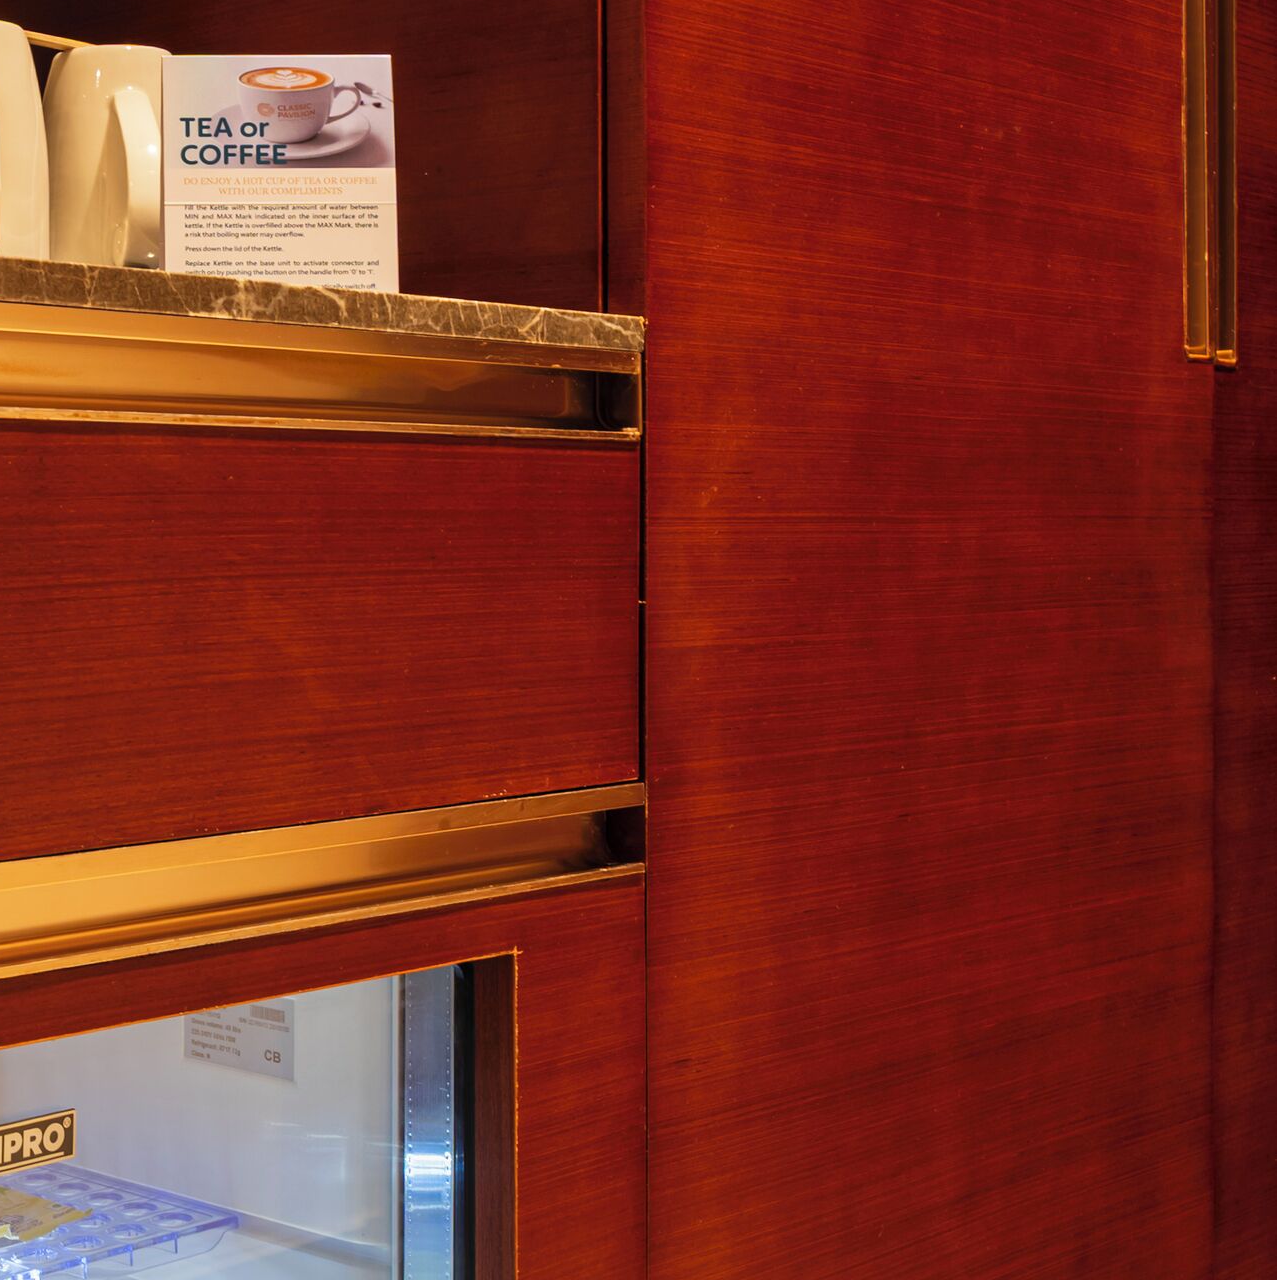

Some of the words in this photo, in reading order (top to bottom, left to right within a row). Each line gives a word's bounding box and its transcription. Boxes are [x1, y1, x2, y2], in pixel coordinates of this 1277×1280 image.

[277, 103, 313, 112] CLASSIC
[277, 110, 316, 118] PAVILION
[179, 117, 233, 138] TEA
[240, 122, 270, 138] or
[180, 144, 288, 165] COFFEE
[183, 177, 198, 186] DO
[200, 177, 232, 186] ENJOY
[233, 177, 241, 185] A
[242, 177, 263, 185] HOT
[265, 176, 286, 185] CUP
[288, 176, 300, 185] OF
[303, 176, 321, 185] TEA
[323, 176, 339, 185] OR
[339, 176, 378, 185] COFFEE
[218, 187, 246, 196] WITH
[247, 187, 269, 195] OUR
[270, 186, 344, 195] COMPLIMENTS
[261, 204, 289, 212] required
[216, 231, 239, 239] boiling
[185, 260, 211, 268] Replace
[226, 269, 252, 277] pushing
[264, 1049, 281, 1063] CB
